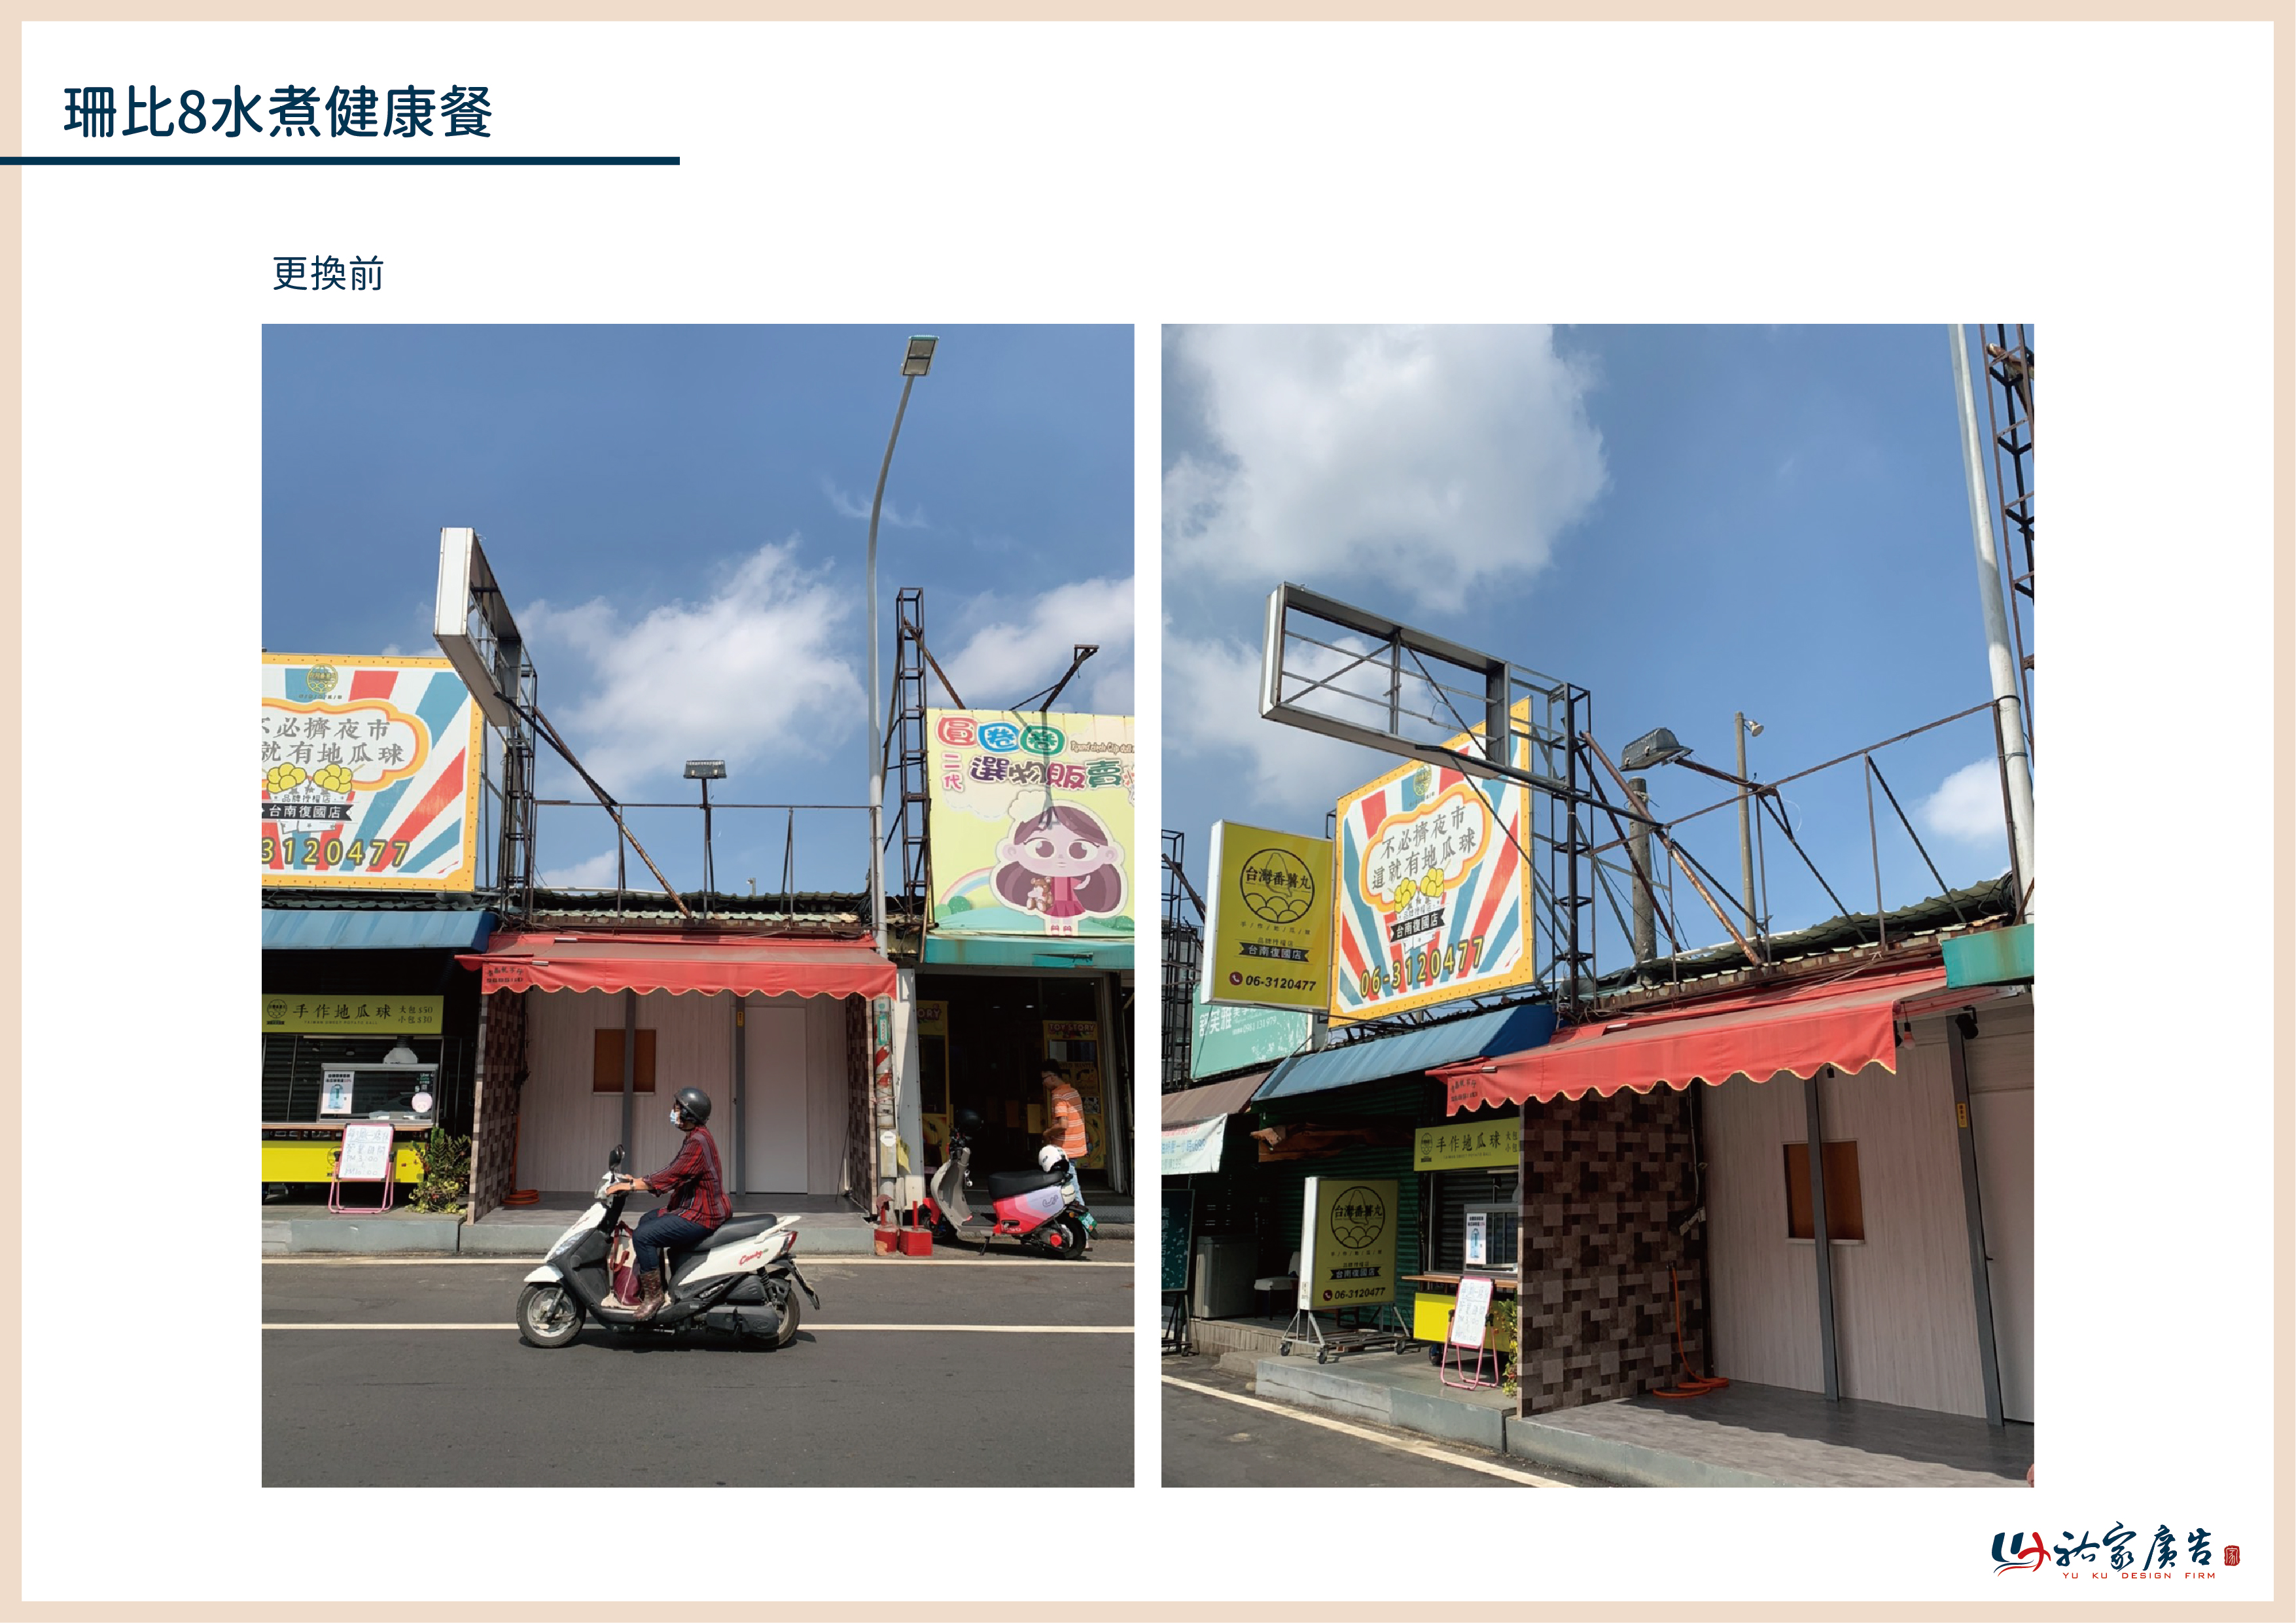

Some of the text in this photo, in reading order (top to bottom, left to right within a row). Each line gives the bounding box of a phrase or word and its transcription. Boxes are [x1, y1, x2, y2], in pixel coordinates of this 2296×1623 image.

[269, 804, 342, 819] 台南復國店
[1381, 805, 1466, 860] 不必擠夜市
[1372, 827, 1476, 890] 這就有地瓜球
[1360, 935, 1485, 998] 06-3120477
[1245, 974, 1317, 992] 06-3120477
[293, 1003, 393, 1019] 手作地瓜球
[1436, 1130, 1501, 1153] 手作地瓜球
[1334, 1287, 1386, 1299] 06-3120477
